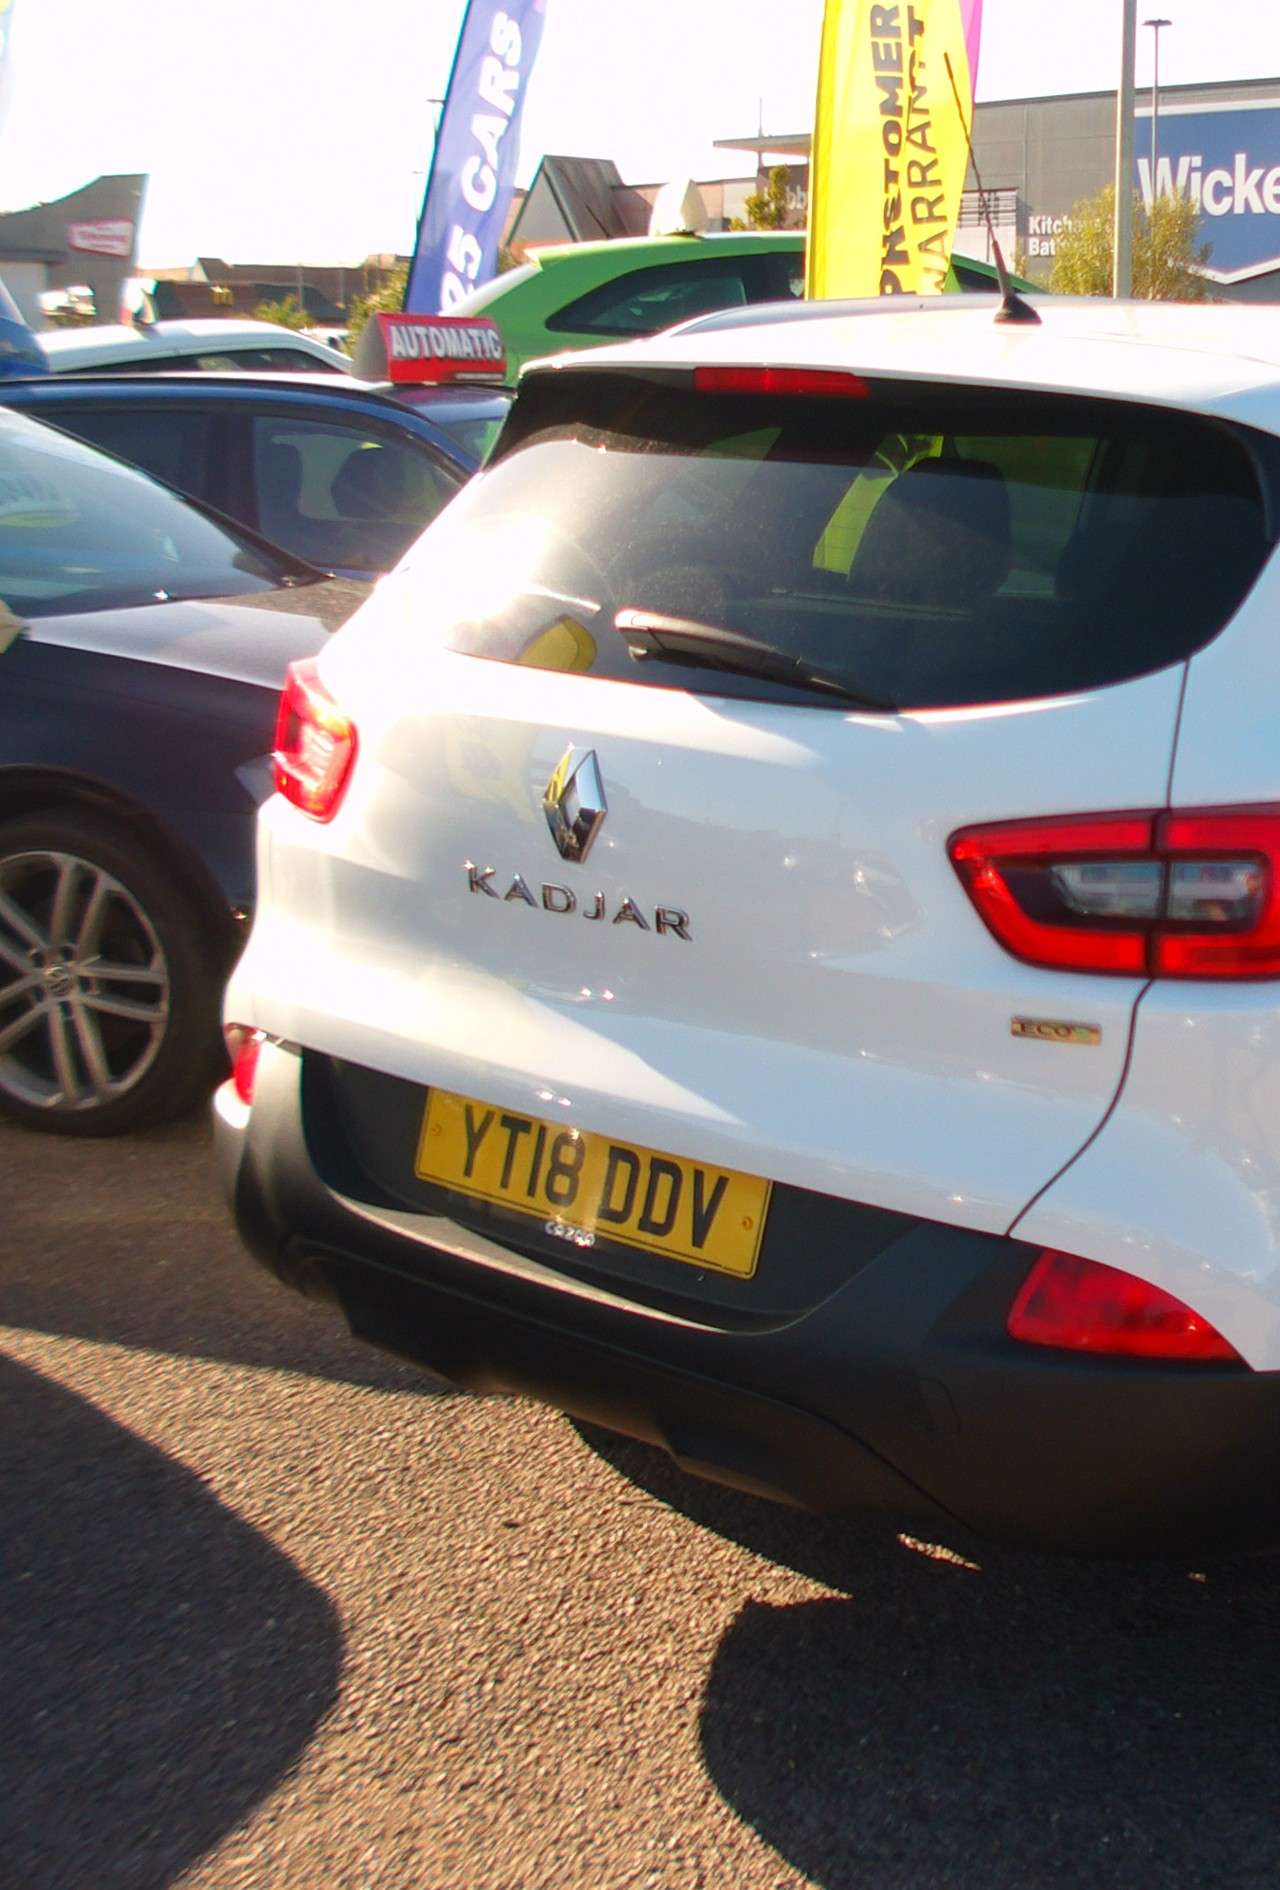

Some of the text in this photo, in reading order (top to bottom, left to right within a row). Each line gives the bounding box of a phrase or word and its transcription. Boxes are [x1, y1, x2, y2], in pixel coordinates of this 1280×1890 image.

[461, 11, 522, 212] CARS
[389, 325, 502, 359] AUTOMATIC
[463, 858, 693, 942] KADJAR
[463, 1103, 730, 1249] YT18 DDV
